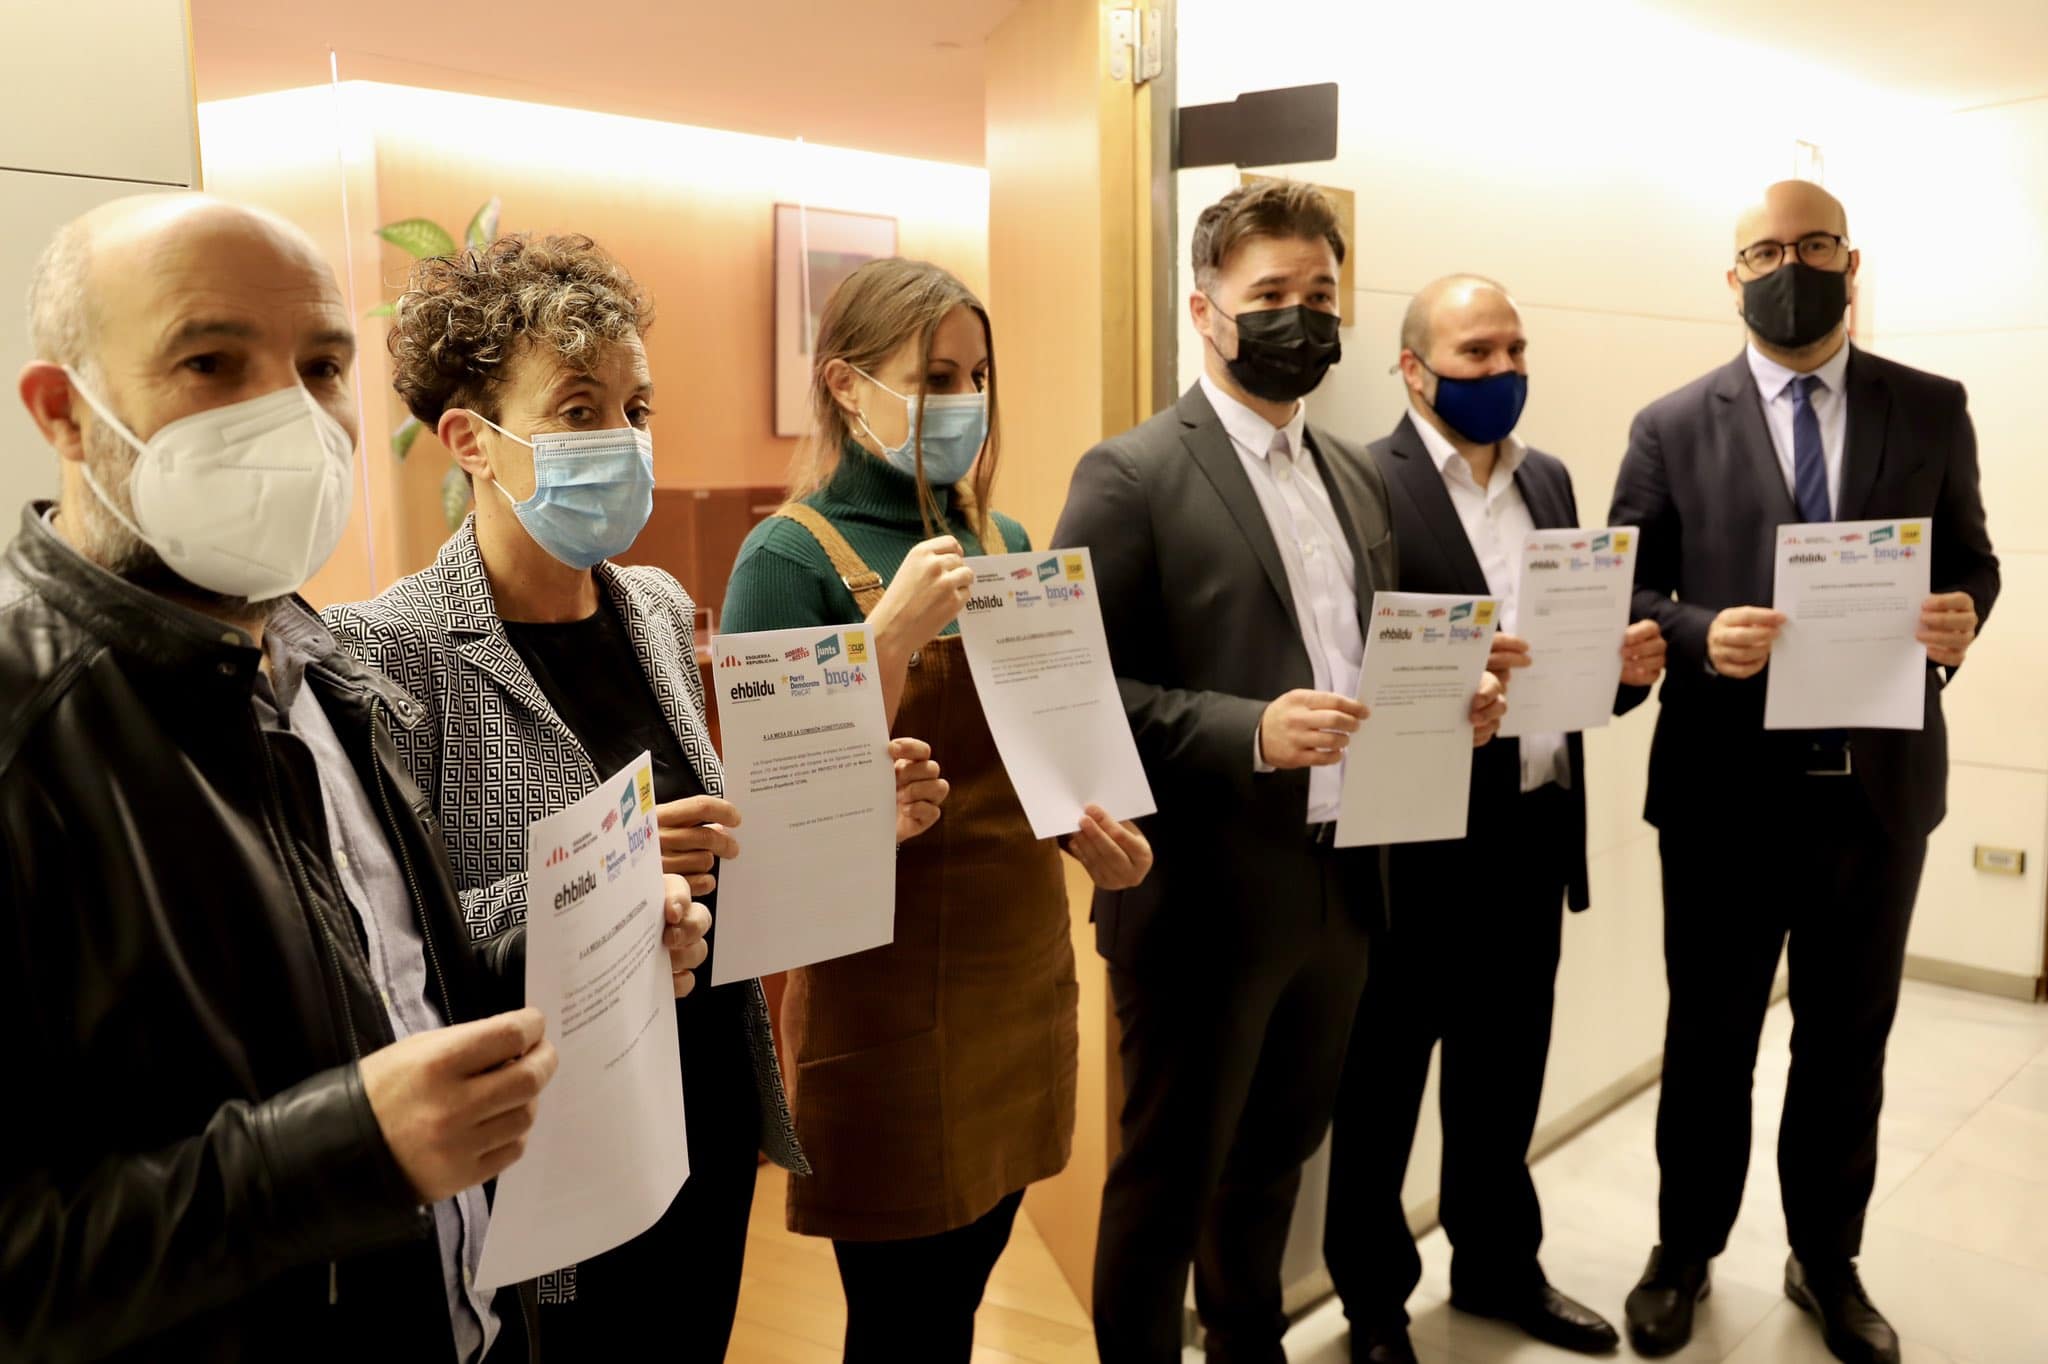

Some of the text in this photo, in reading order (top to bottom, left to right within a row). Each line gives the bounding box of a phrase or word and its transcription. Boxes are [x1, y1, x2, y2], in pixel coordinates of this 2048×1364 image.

[1045, 585, 1068, 600] bng
[966, 595, 1003, 611] ehbildu
[817, 645, 837, 658] junts
[824, 668, 850, 687] bng
[731, 680, 775, 700] ehbildu
[554, 870, 597, 910] ehbildu
